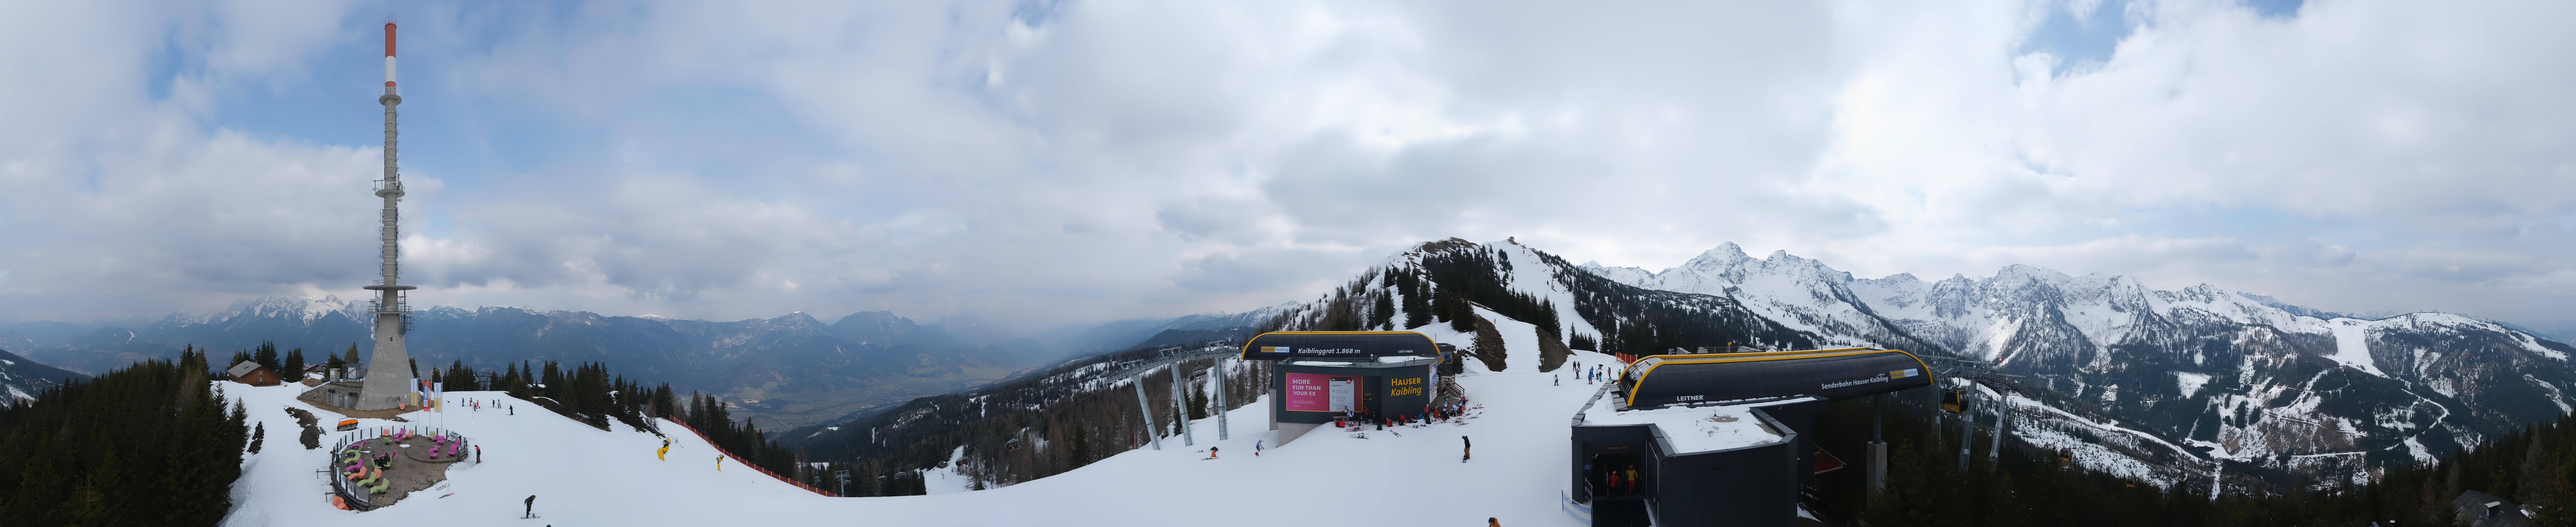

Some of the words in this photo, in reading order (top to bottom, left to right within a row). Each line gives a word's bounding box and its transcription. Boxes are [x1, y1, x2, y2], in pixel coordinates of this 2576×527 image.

[1391, 378, 1421, 386] HAUSER
[1822, 380, 1852, 389] Senderbahn
[1391, 386, 1421, 396] Kaibling
